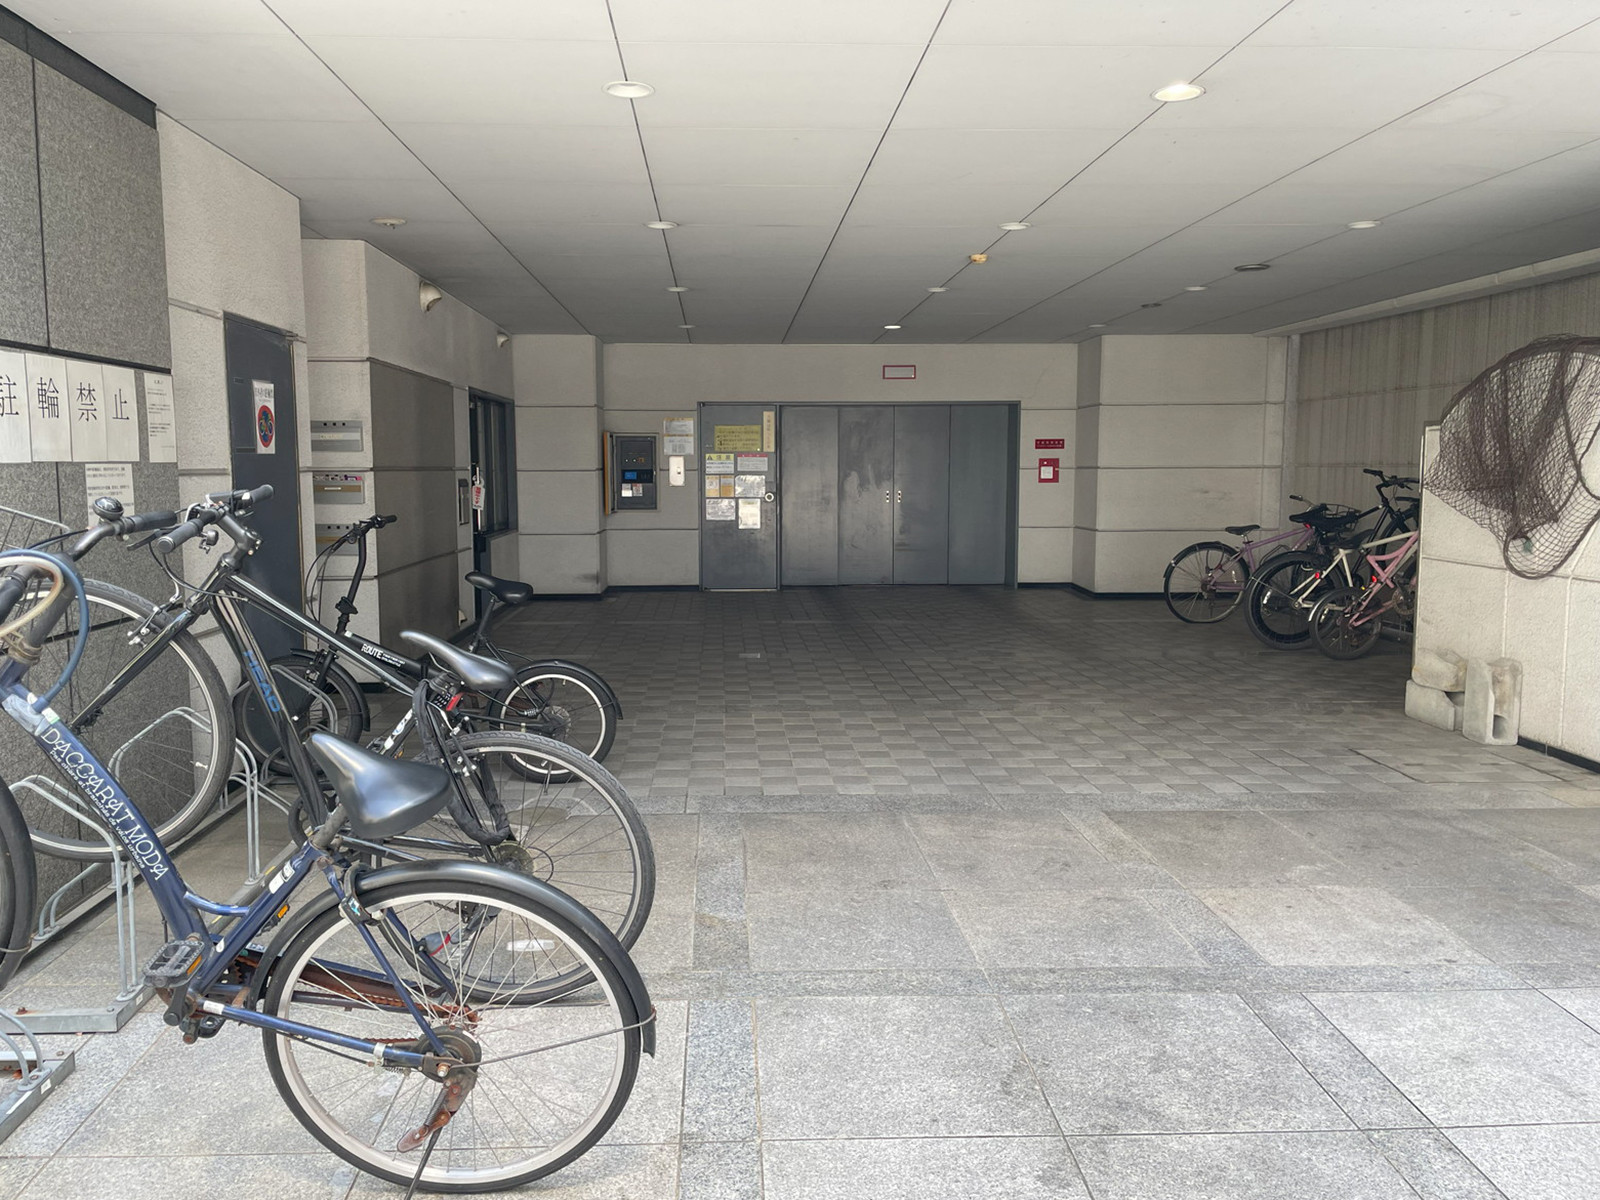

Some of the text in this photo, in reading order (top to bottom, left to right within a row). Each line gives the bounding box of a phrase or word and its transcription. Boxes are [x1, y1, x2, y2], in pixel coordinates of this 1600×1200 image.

[243, 650, 281, 712] HEAD
[361, 643, 384, 660] ROUTE
[41, 728, 169, 881] DACCARAT MODA
